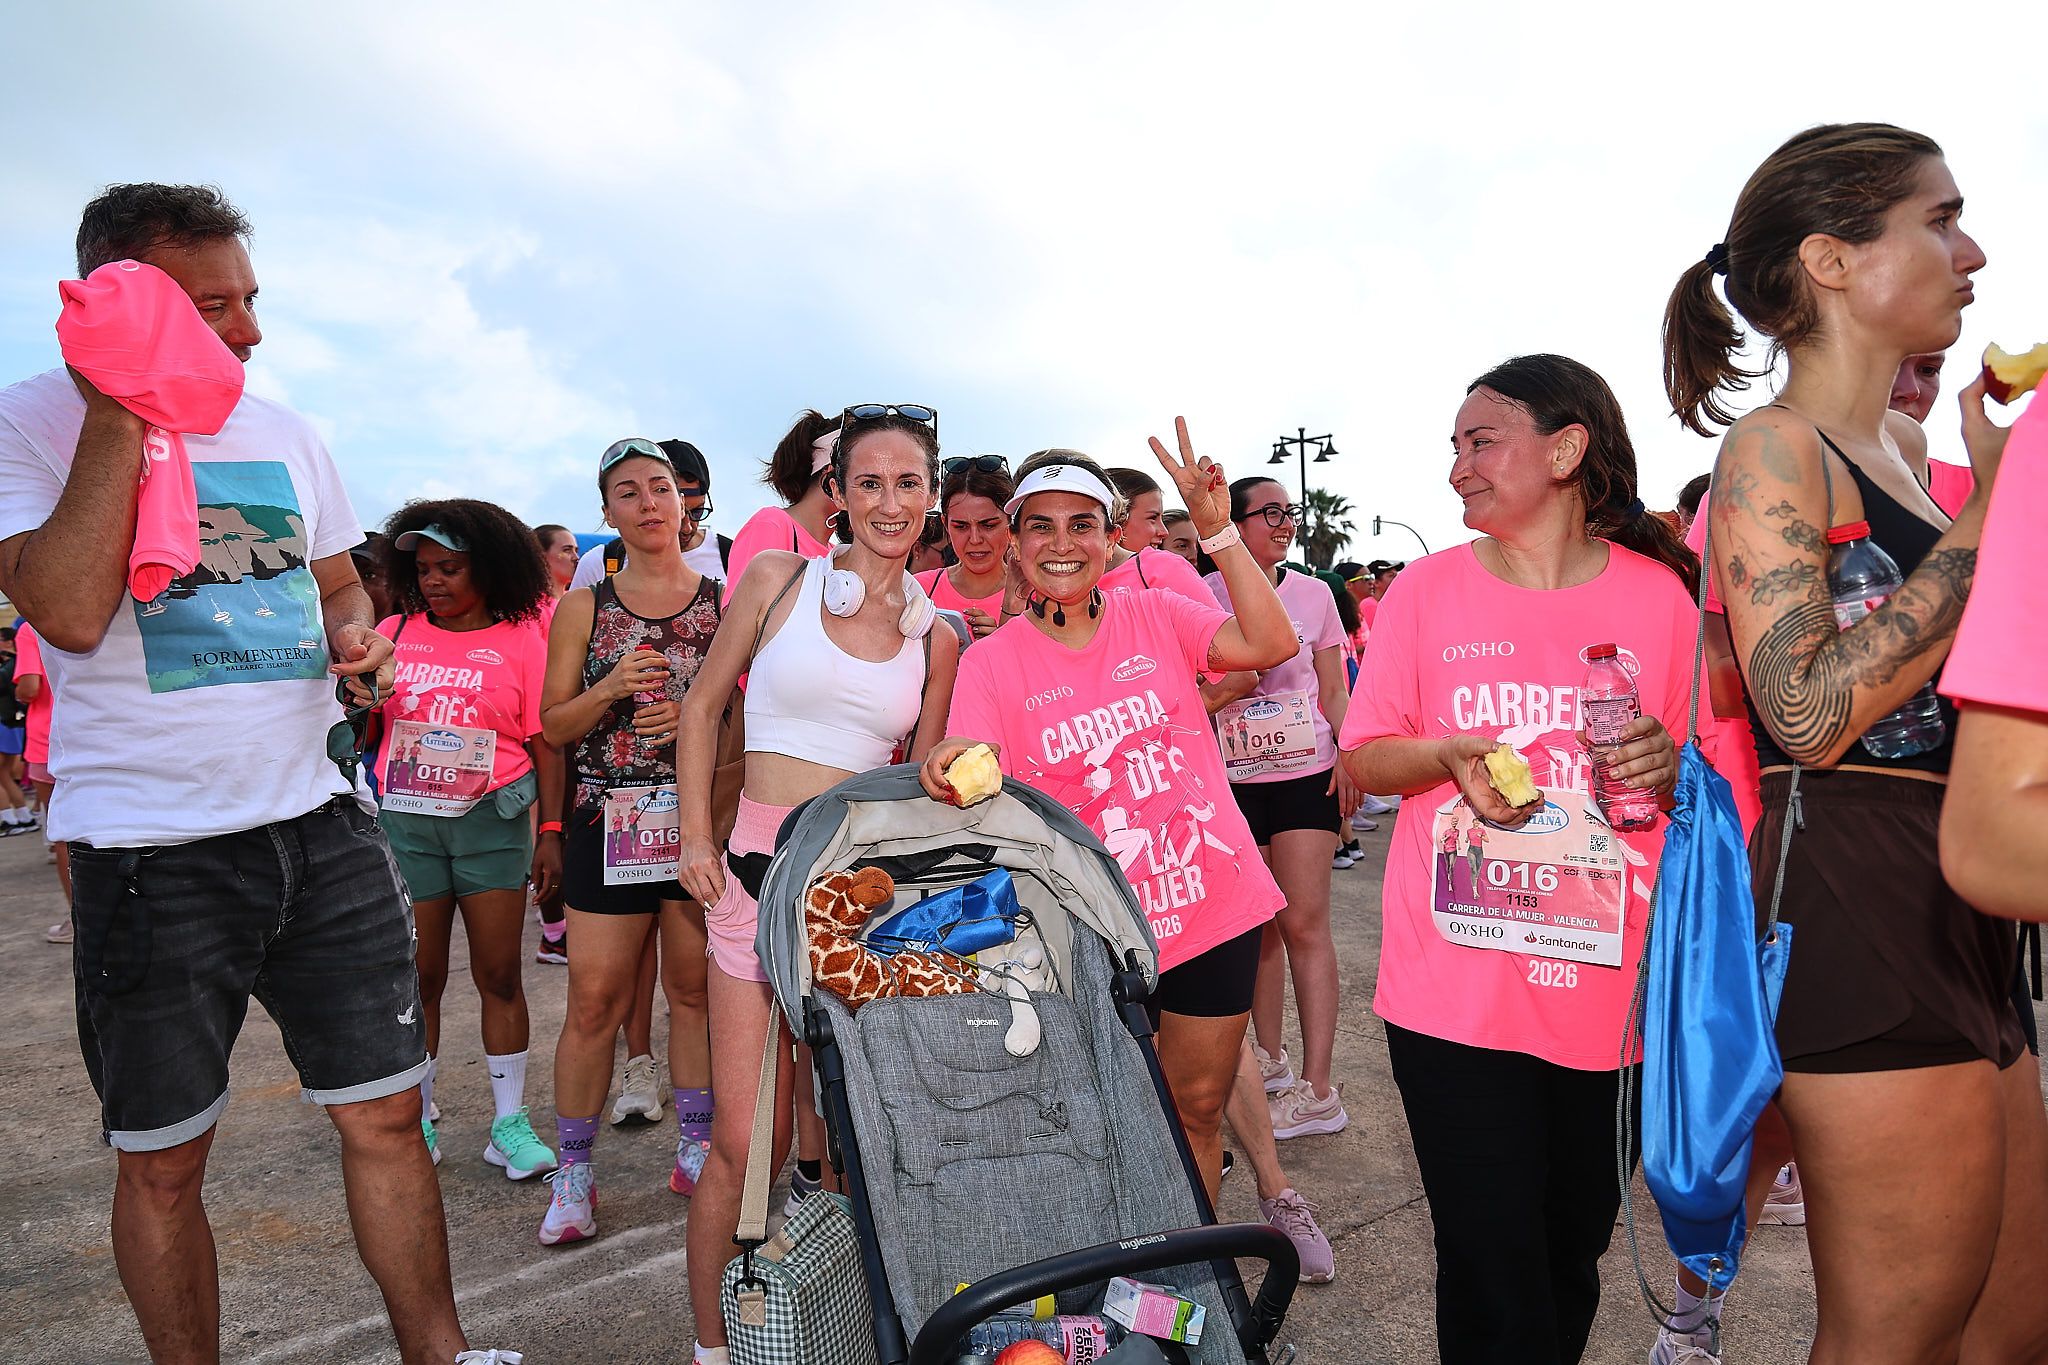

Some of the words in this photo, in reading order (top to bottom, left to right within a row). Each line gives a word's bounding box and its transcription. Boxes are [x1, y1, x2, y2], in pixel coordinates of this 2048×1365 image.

[192, 647, 312, 667] FORMENTERA
[1443, 641, 1515, 663] OYSHO
[226, 663, 264, 672] BALEARIC
[266, 661, 294, 669] ISLANDS
[395, 661, 484, 692] CARRERA
[1025, 686, 1074, 712] OYSHO
[1453, 682, 1584, 731] CARRE
[1246, 707, 1281, 718] ASTURIANA
[1040, 689, 1169, 765] CARRERA
[424, 736, 462, 748] ASTURIANA
[1251, 731, 1286, 748] 016
[1261, 747, 1279, 755] 4245
[1122, 740, 1172, 801] DE
[1236, 763, 1264, 777] OYSHO
[1280, 760, 1308, 769] Santander
[416, 764, 457, 783] 016
[428, 783, 443, 792] 615
[391, 797, 423, 809] OYSHO
[640, 827, 680, 846] 016
[651, 847, 670, 856] 2141
[617, 868, 652, 879] OYSHO
[1486, 860, 1559, 892] 016
[1130, 864, 1207, 917] UJER
[1506, 893, 1538, 908] 1153
[1448, 902, 1485, 916] CARRERA
[1488, 908, 1500, 917] DE
[1502, 909, 1513, 918] LA
[1515, 910, 1545, 922] MUJER
[1553, 914, 1599, 928] VALENCIA
[1151, 914, 1183, 939] 026
[1450, 922, 1504, 939] OYSHO
[1538, 935, 1598, 951] Santander
[1527, 959, 1578, 989] 2026
[966, 1017, 999, 1028] Inglesina
[1118, 1234, 1167, 1250] Inglesina
